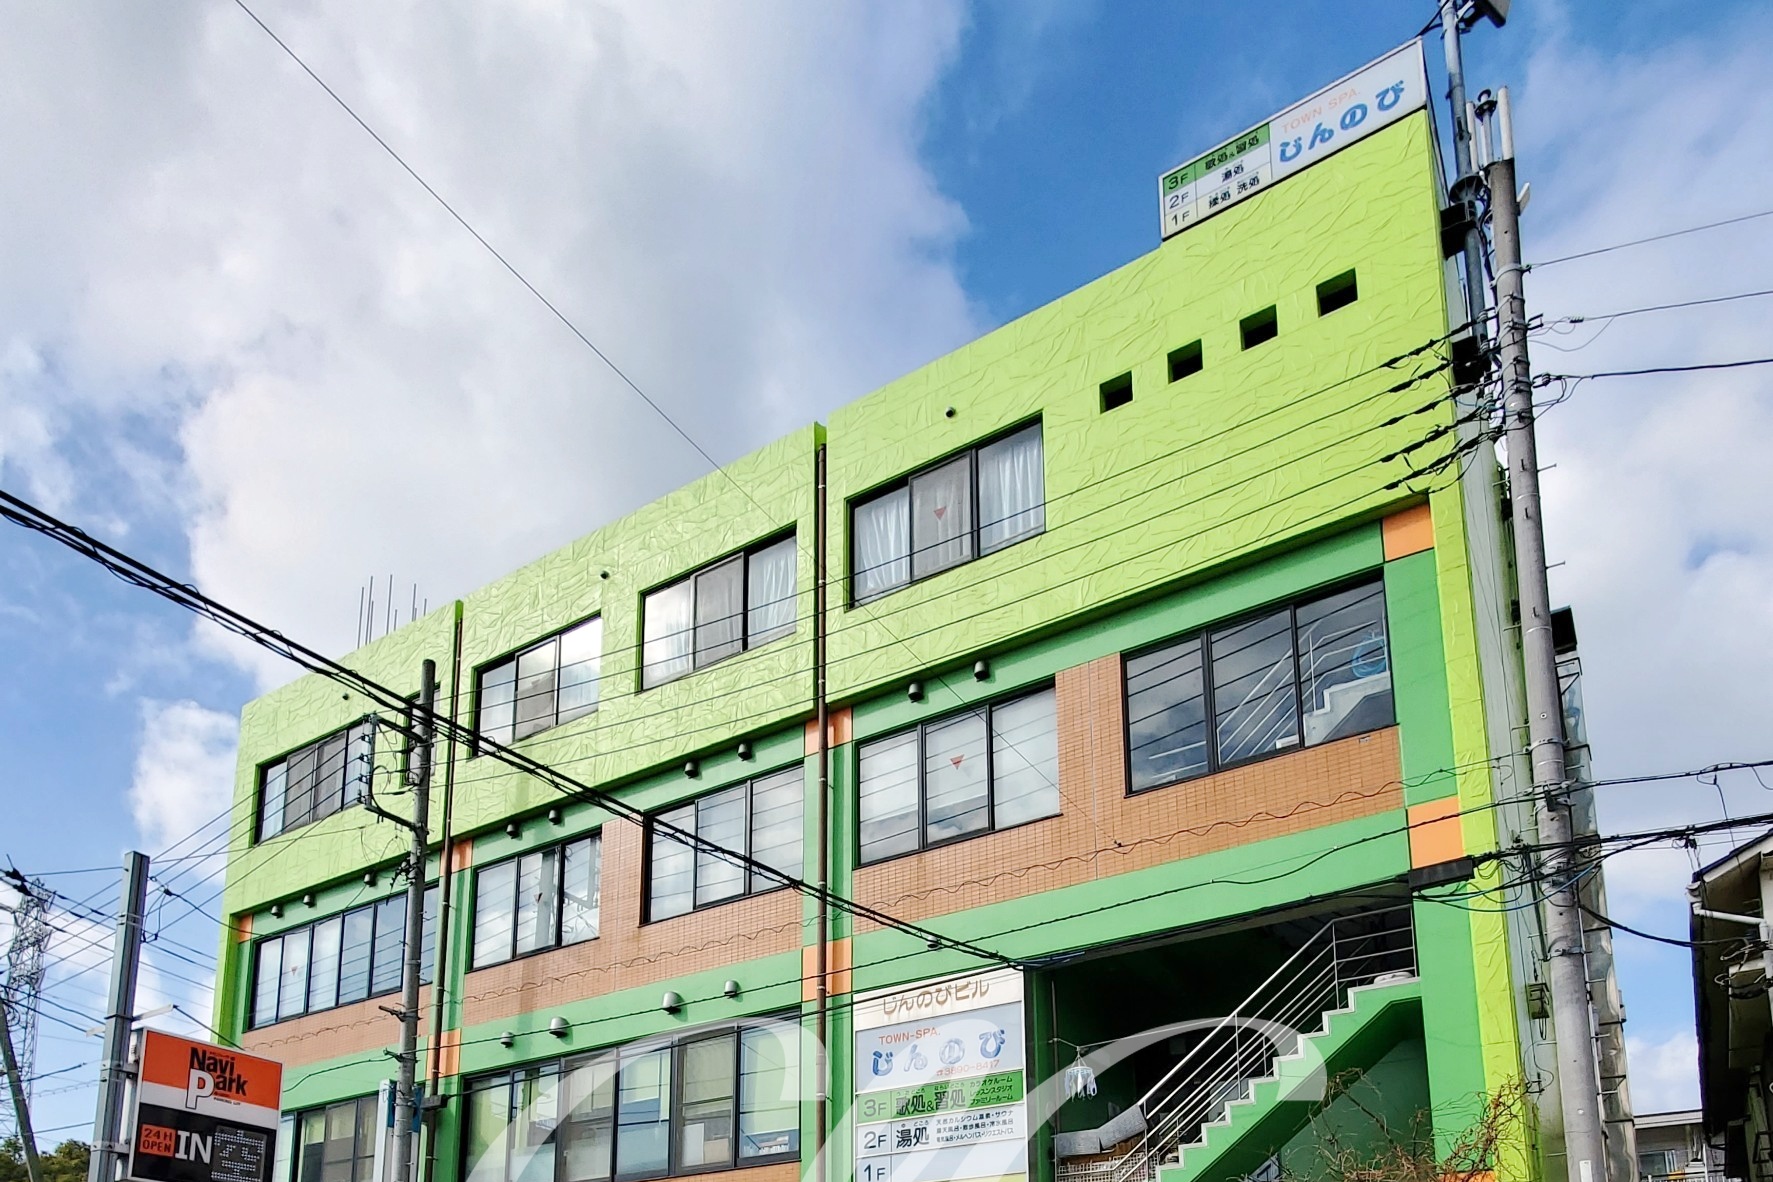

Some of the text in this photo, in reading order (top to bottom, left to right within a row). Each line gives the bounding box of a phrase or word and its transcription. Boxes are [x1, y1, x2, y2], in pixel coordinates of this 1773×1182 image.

[1280, 80, 1405, 162] じんのび
[1282, 106, 1322, 133] TOWN
[1168, 173, 1189, 190] 3F
[1169, 191, 1189, 209] 2F
[1171, 210, 1190, 226] 1F
[883, 979, 989, 1015] じんのびビル
[190, 1046, 236, 1076] Navi
[872, 1029, 1005, 1076] じんのび
[185, 1068, 248, 1110] Park
[970, 1076, 1013, 1088] カラオケルーム
[970, 1085, 1013, 1097] レッスンスタジオ
[863, 1088, 966, 1117] 3F 歌処&習処
[970, 1094, 1013, 1106] ファミリールーム
[142, 1139, 172, 1153] OPEN
[175, 1130, 213, 1165] IN
[863, 1127, 929, 1149] 2F 湯処
[863, 1164, 886, 1182] 1F
